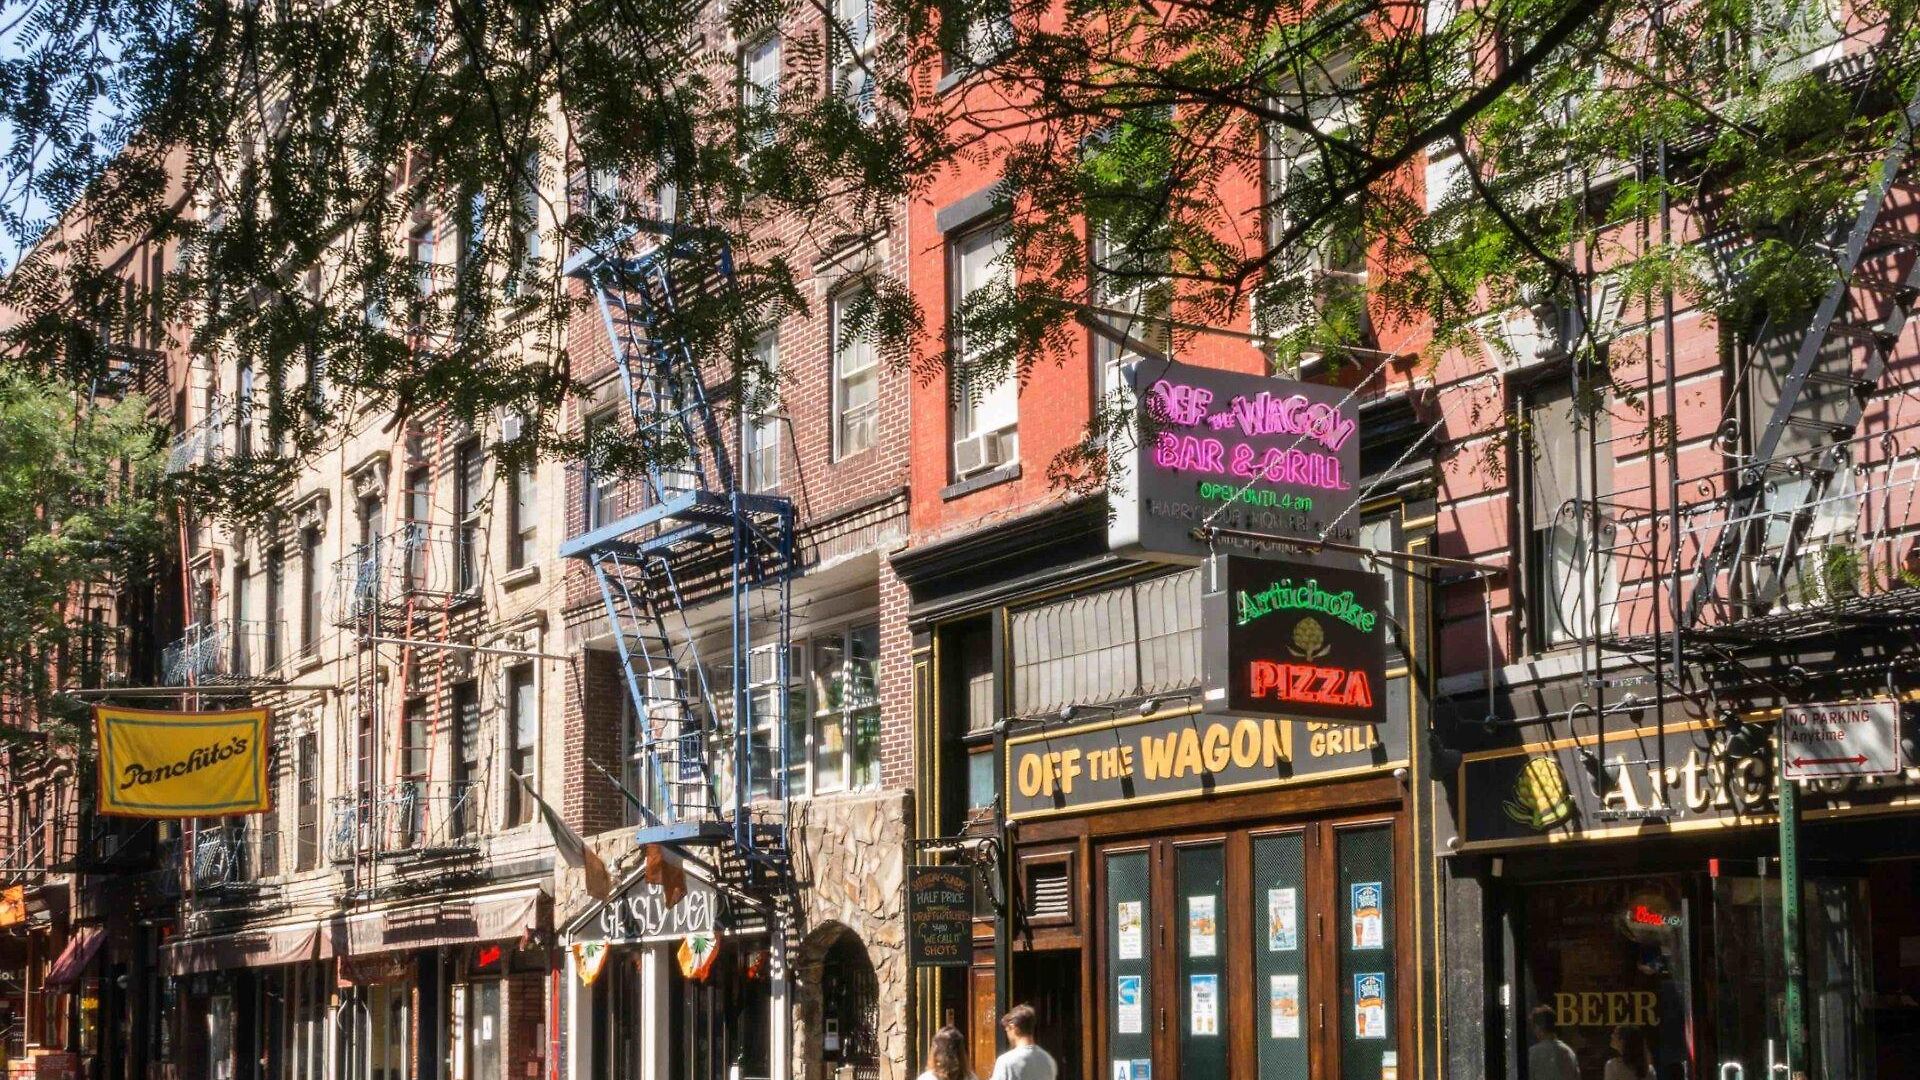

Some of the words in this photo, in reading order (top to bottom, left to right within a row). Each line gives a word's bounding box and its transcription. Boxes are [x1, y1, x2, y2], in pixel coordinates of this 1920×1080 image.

[1149, 379, 1214, 425] OFF
[1232, 390, 1356, 452] WAGON
[1157, 431, 1225, 473] BAR
[1232, 443, 1257, 479] &
[1264, 448, 1352, 490] GRILL
[1243, 487, 1281, 508] UNTIL
[1236, 578, 1378, 633] Artichoke
[1250, 660, 1373, 708] PIZZA
[1790, 713, 1808, 726] NO
[1812, 709, 1870, 725] PARKING
[1791, 728, 1845, 745] Anytime
[120, 736, 248, 790] Panchito's
[1018, 748, 1081, 798] OFF
[1087, 745, 1134, 782] THE
[1141, 718, 1294, 781] WAGON
[916, 891, 939, 905] HALF
[941, 891, 965, 904] PRICE
[924, 944, 958, 956] SHOTS
[1554, 991, 1661, 1027] BEER
